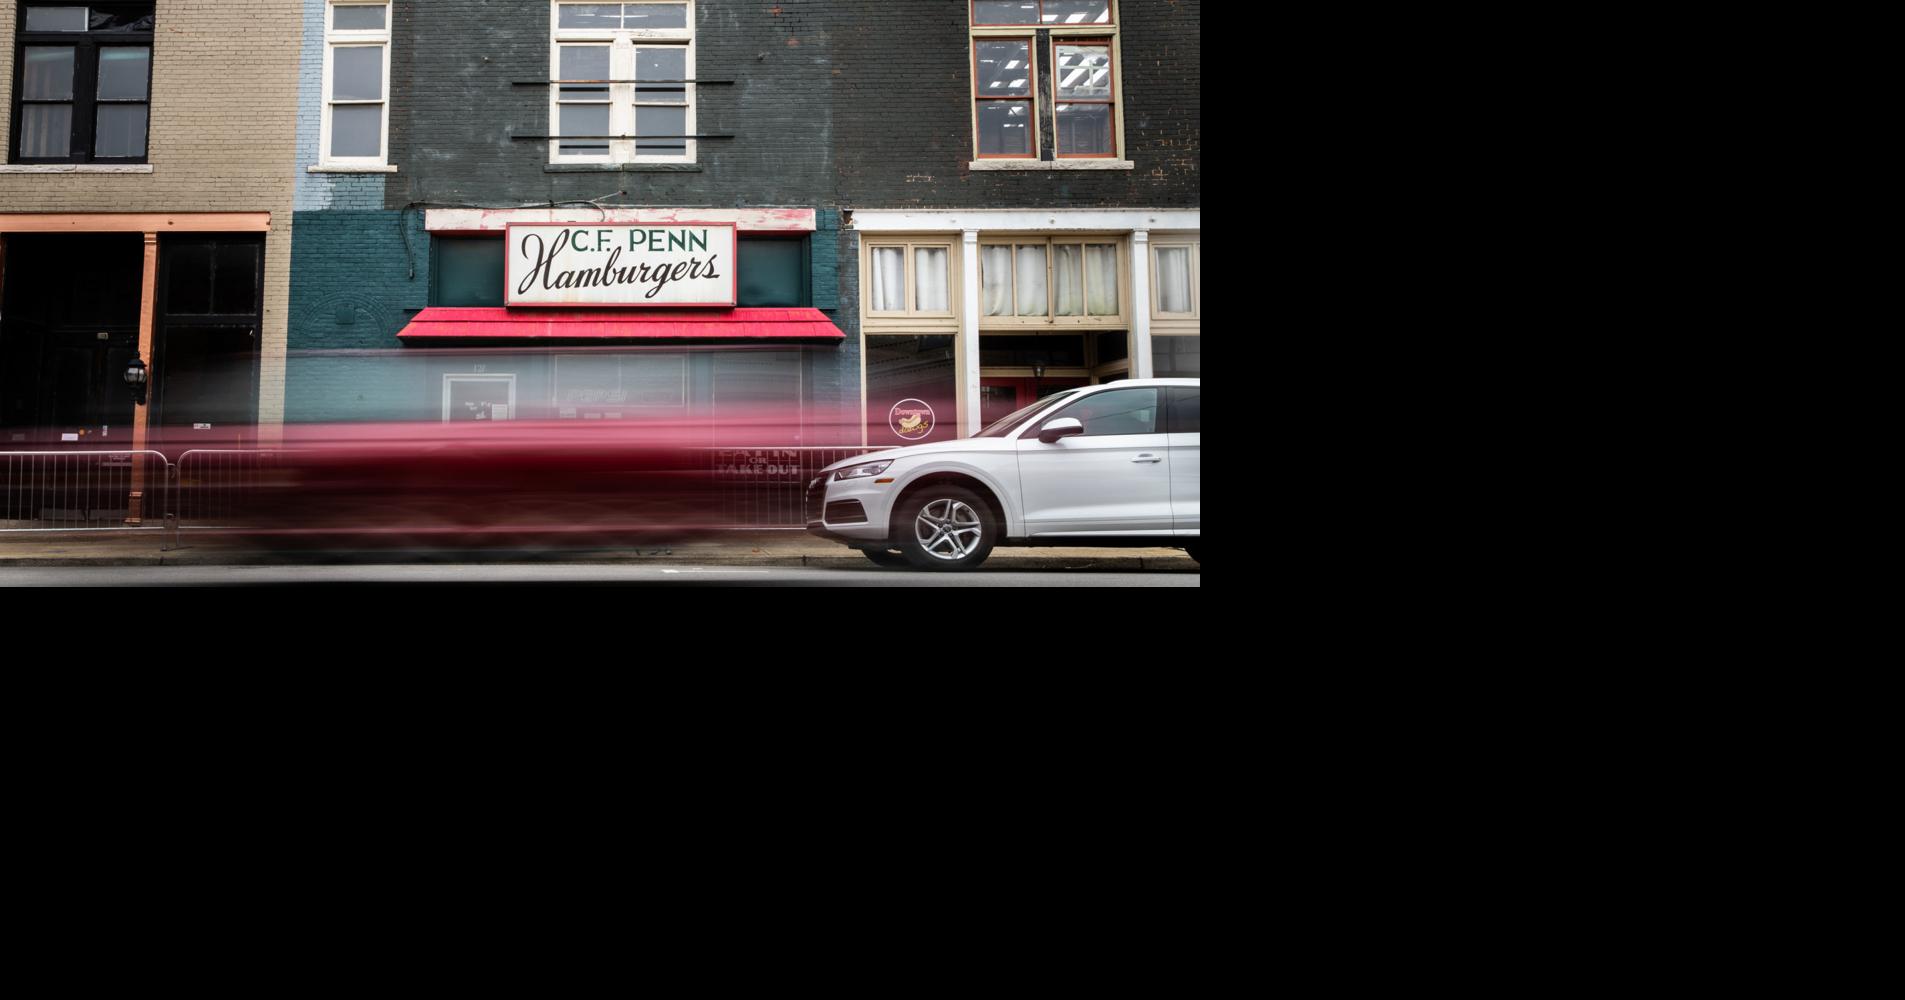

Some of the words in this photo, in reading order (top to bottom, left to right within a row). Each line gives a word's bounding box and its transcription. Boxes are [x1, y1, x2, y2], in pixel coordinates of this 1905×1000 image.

[571, 229, 613, 252] C.F.
[629, 229, 708, 252] PENN
[517, 228, 721, 299] Hamburgers
[717, 464, 764, 475] TAKE
[767, 464, 801, 475] OUT
